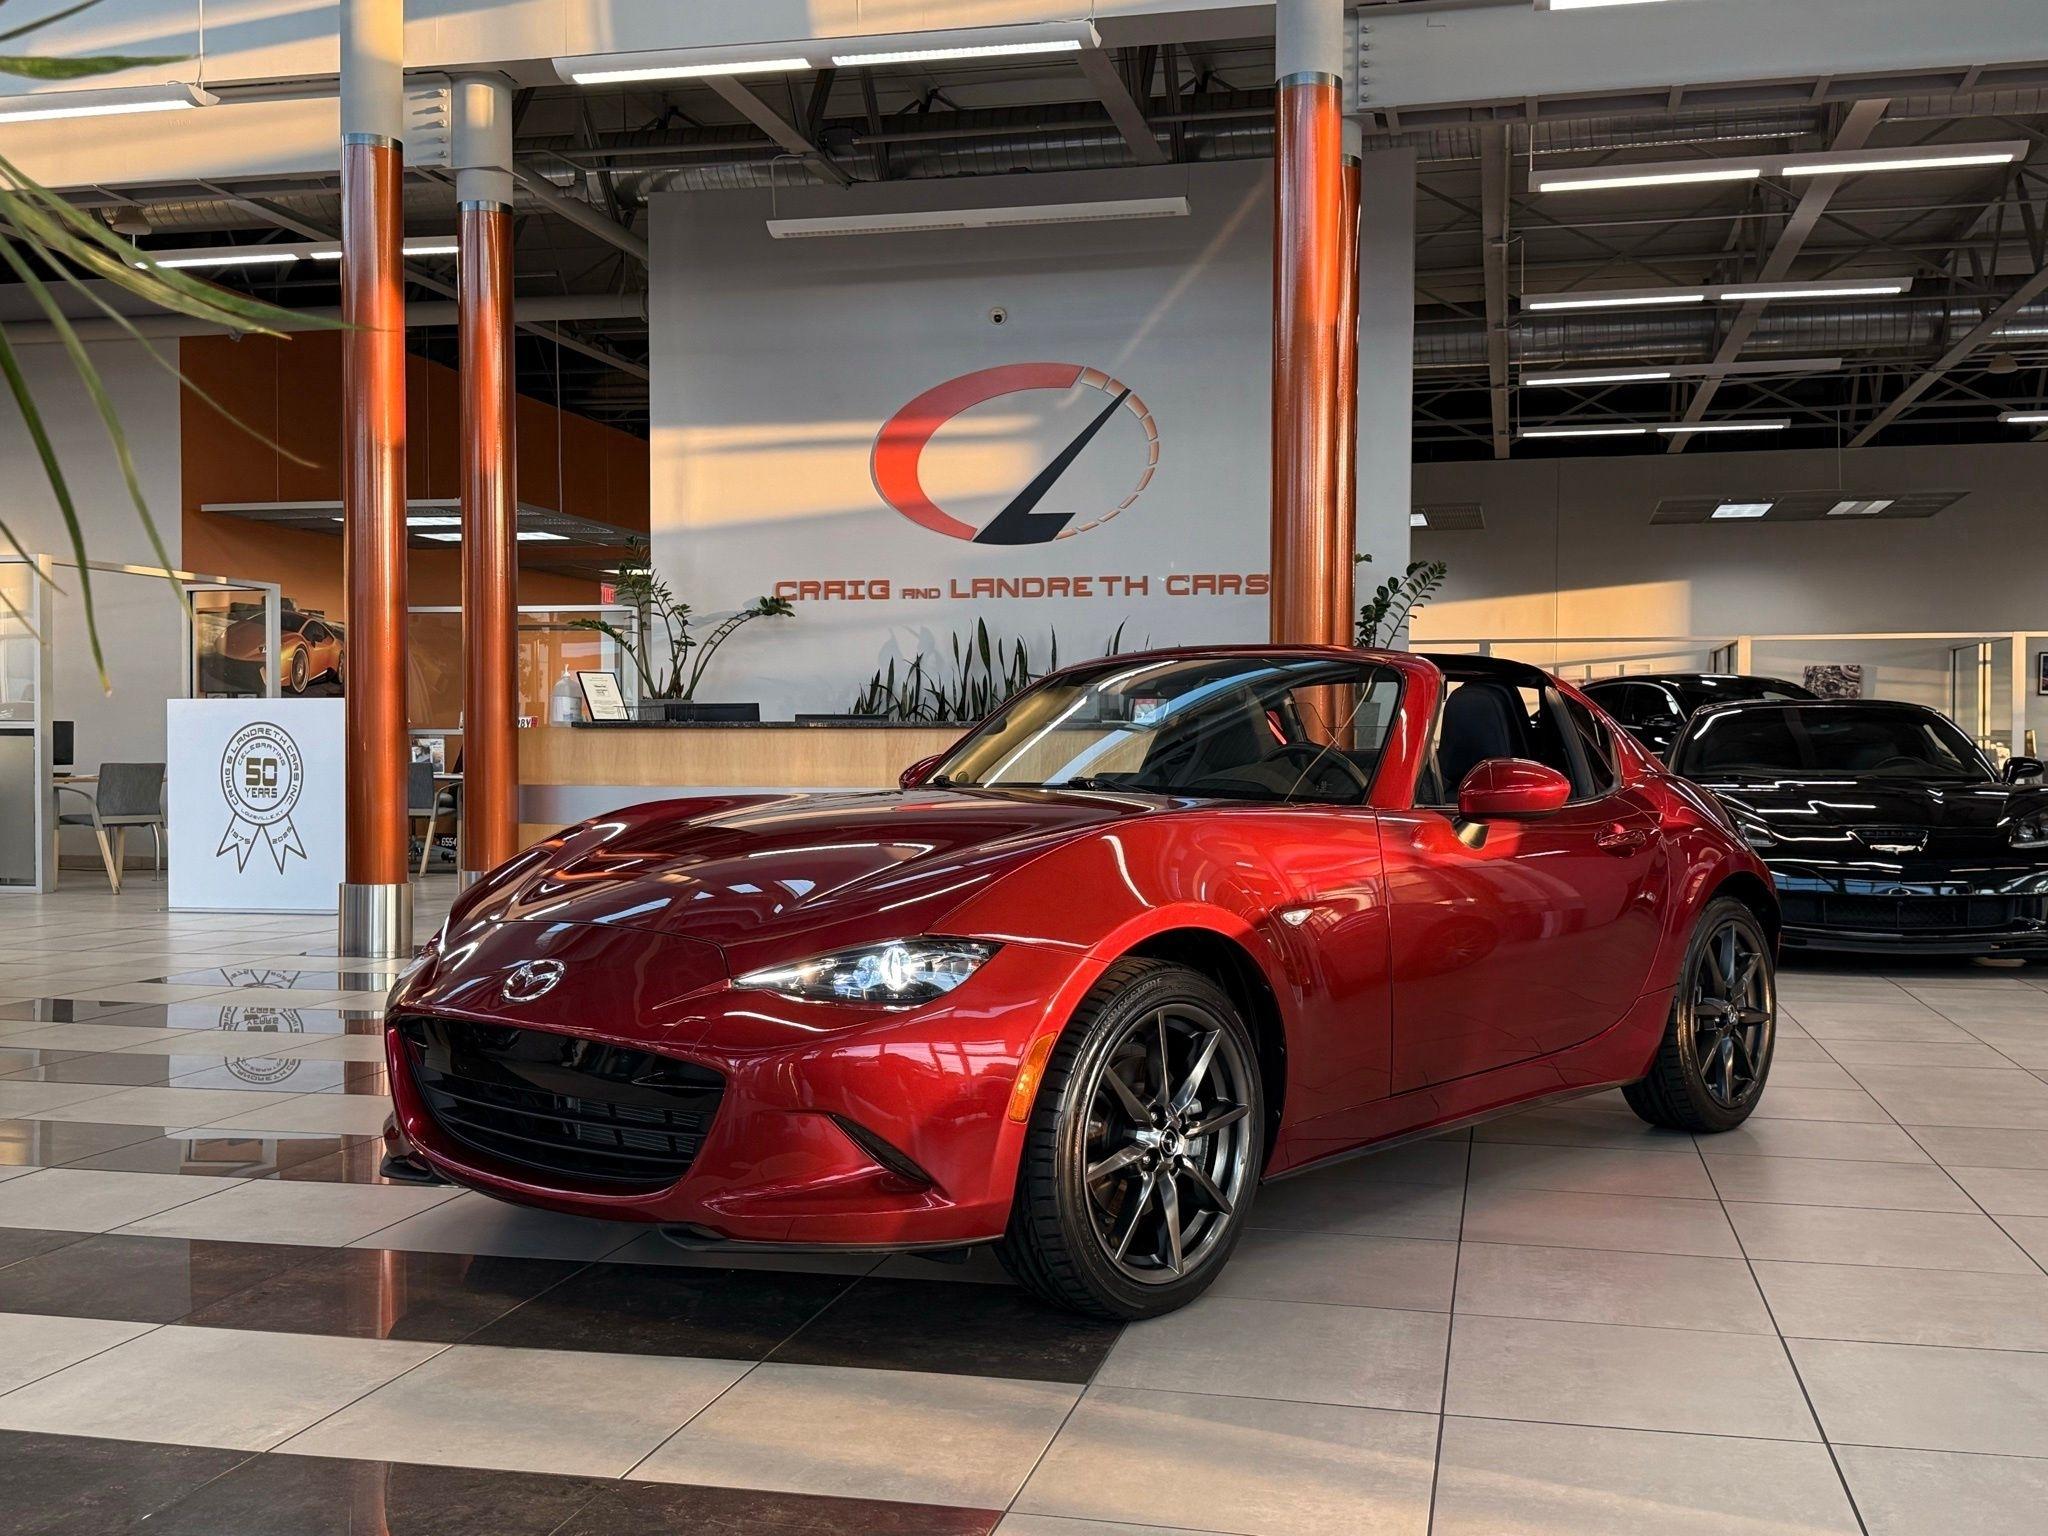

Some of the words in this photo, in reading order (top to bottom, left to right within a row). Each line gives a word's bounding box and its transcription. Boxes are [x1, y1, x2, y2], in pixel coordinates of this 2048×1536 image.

[775, 579, 890, 601] CRAIG
[902, 586, 941, 600] AND
[950, 575, 1149, 599] LANDRETH
[1165, 574, 1271, 597] CARS
[231, 727, 288, 754] LANDRETH
[237, 742, 286, 766] CELEBRATING
[245, 757, 278, 787] 50
[286, 744, 300, 781] CARS
[225, 768, 239, 806] CRAIG
[245, 787, 278, 799] YEARS
[230, 828, 251, 845] 1975
